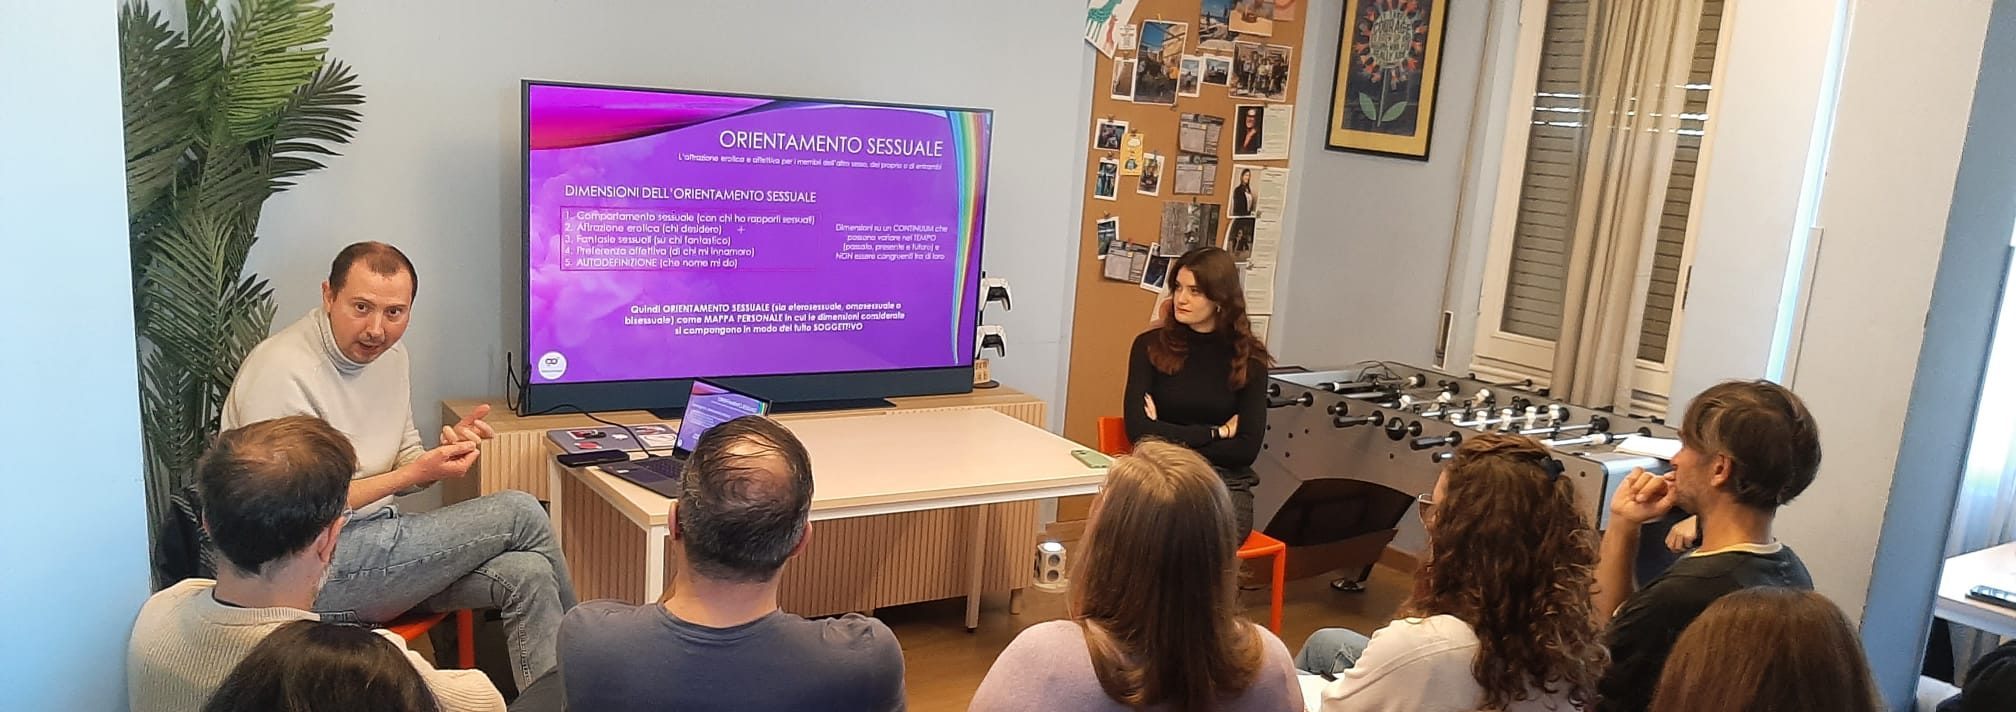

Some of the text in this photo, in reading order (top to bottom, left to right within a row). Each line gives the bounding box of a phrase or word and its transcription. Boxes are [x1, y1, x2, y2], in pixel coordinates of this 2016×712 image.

[720, 130, 943, 157] ORIENTAMENTO SESSUALE
[720, 154, 744, 163] erotica
[781, 158, 792, 166] per
[797, 158, 821, 166] membri
[565, 185, 816, 203] DIMENSIONI DELL'ORIENTAMENTO SESSUALE
[577, 211, 656, 222] Comportamento
[658, 213, 694, 222] sessuale
[719, 213, 732, 222] chi
[734, 214, 746, 223] ho
[747, 215, 781, 225] rapporti
[565, 222, 722, 235] 2. Attrazione erotica (chi desidero)
[836, 223, 873, 232] Dimensioni
[935, 224, 948, 233] che
[565, 235, 573, 244] 3.
[577, 235, 616, 244] Fantasie
[618, 235, 652, 244] sessuali
[654, 235, 666, 245] (su
[669, 235, 682, 244] chi
[902, 233, 913, 241] nel
[577, 247, 626, 256] Preferenza
[629, 247, 667, 256] affettiva
[670, 247, 680, 257] (di
[683, 247, 696, 256] chi
[698, 247, 708, 256] mi
[710, 247, 755, 258] innamoro)
[836, 252, 853, 260] NON
[565, 258, 738, 268] 5. AUTODEFINIZIONE (che nome mi do)
[631, 304, 661, 314] Quindi
[663, 304, 730, 314] ORIENTAMENTO
[731, 303, 770, 313] SESSUALE
[771, 303, 787, 313] (sia
[846, 302, 895, 310] omosessuale
[624, 311, 905, 326] bisessuale) come MAPPA PERSONALE in cui le dimensioni considerate
[675, 326, 682, 335] si
[683, 326, 742, 336] compongono
[743, 325, 751, 334] in
[753, 324, 777, 333] modo
[779, 323, 792, 332] del
[813, 322, 863, 332] SOGGETTIVO
